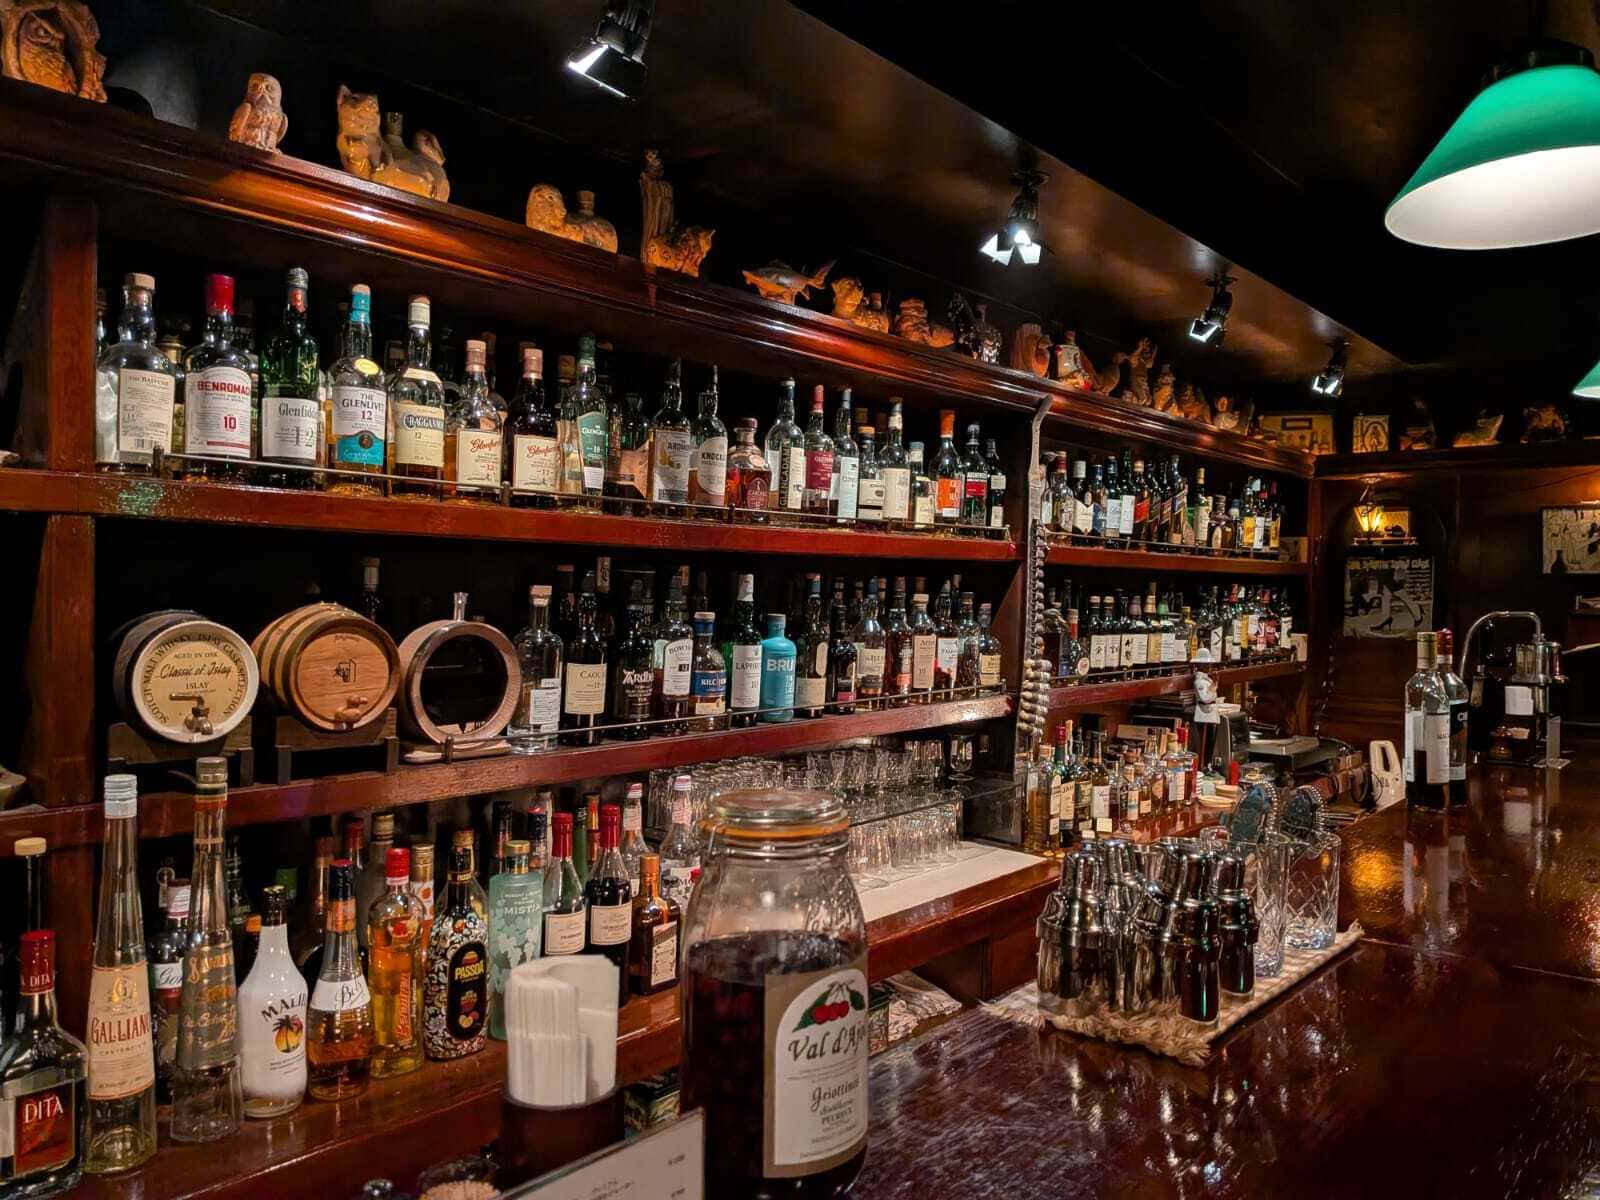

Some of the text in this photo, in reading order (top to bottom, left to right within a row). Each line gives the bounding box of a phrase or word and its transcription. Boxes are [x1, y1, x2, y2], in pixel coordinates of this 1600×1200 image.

[360, 392, 374, 401] THE
[223, 415, 237, 429] 10
[361, 410, 374, 421] 12
[143, 657, 157, 685] MALT
[155, 633, 191, 657] WHISKY
[222, 642, 241, 665] CASK
[158, 662, 192, 680] Classic
[207, 661, 232, 680] Islay
[185, 681, 209, 690] ISLAY
[454, 960, 484, 981] PASSOA
[29, 974, 50, 987] DITA
[787, 1031, 831, 1062] Val
[24, 1096, 64, 1124] DITA
